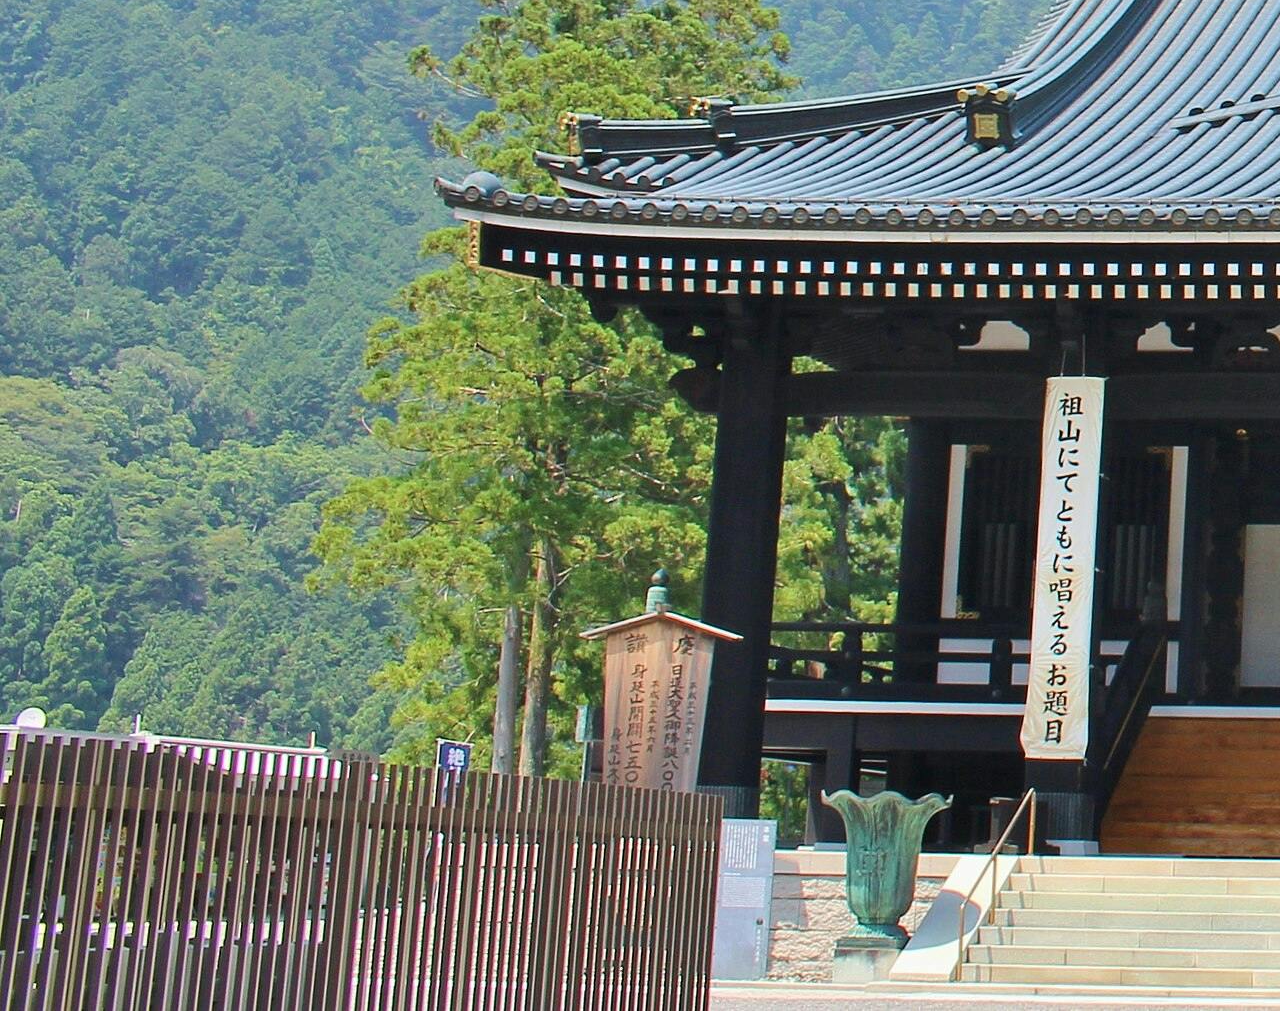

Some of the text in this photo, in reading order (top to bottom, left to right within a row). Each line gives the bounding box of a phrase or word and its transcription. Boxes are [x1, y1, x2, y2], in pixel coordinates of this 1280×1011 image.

[1043, 392, 1083, 744] 祖山にてともに唱えるお題目
